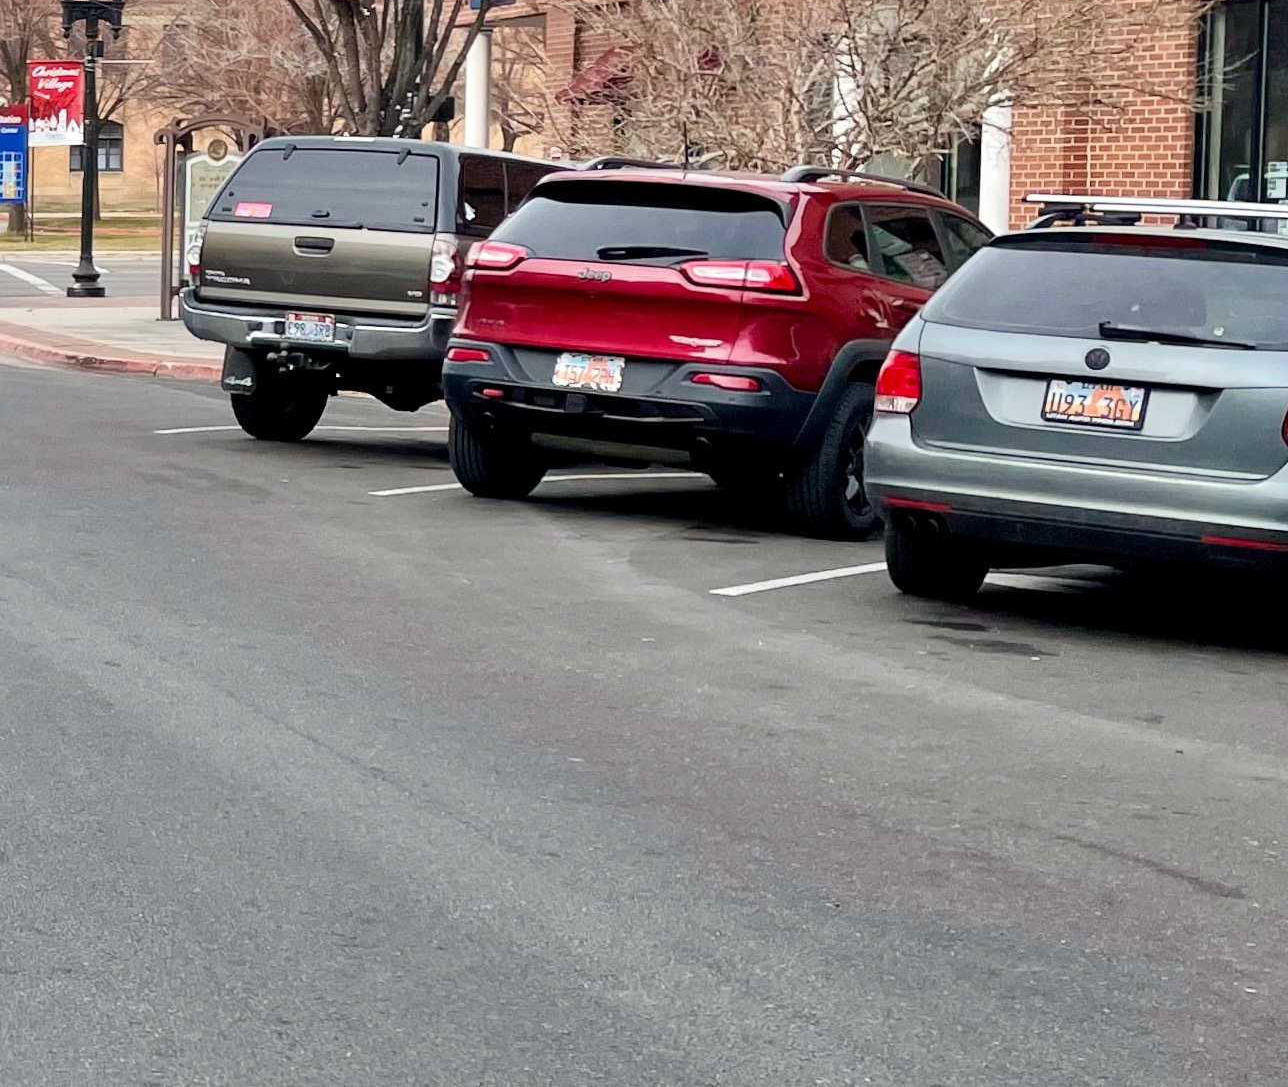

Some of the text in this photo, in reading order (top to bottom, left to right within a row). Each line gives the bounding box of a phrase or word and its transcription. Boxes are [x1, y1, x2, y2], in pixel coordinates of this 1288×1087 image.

[31, 65, 81, 78] Christmas
[37, 79, 74, 93] Village
[577, 268, 612, 282] Jeep
